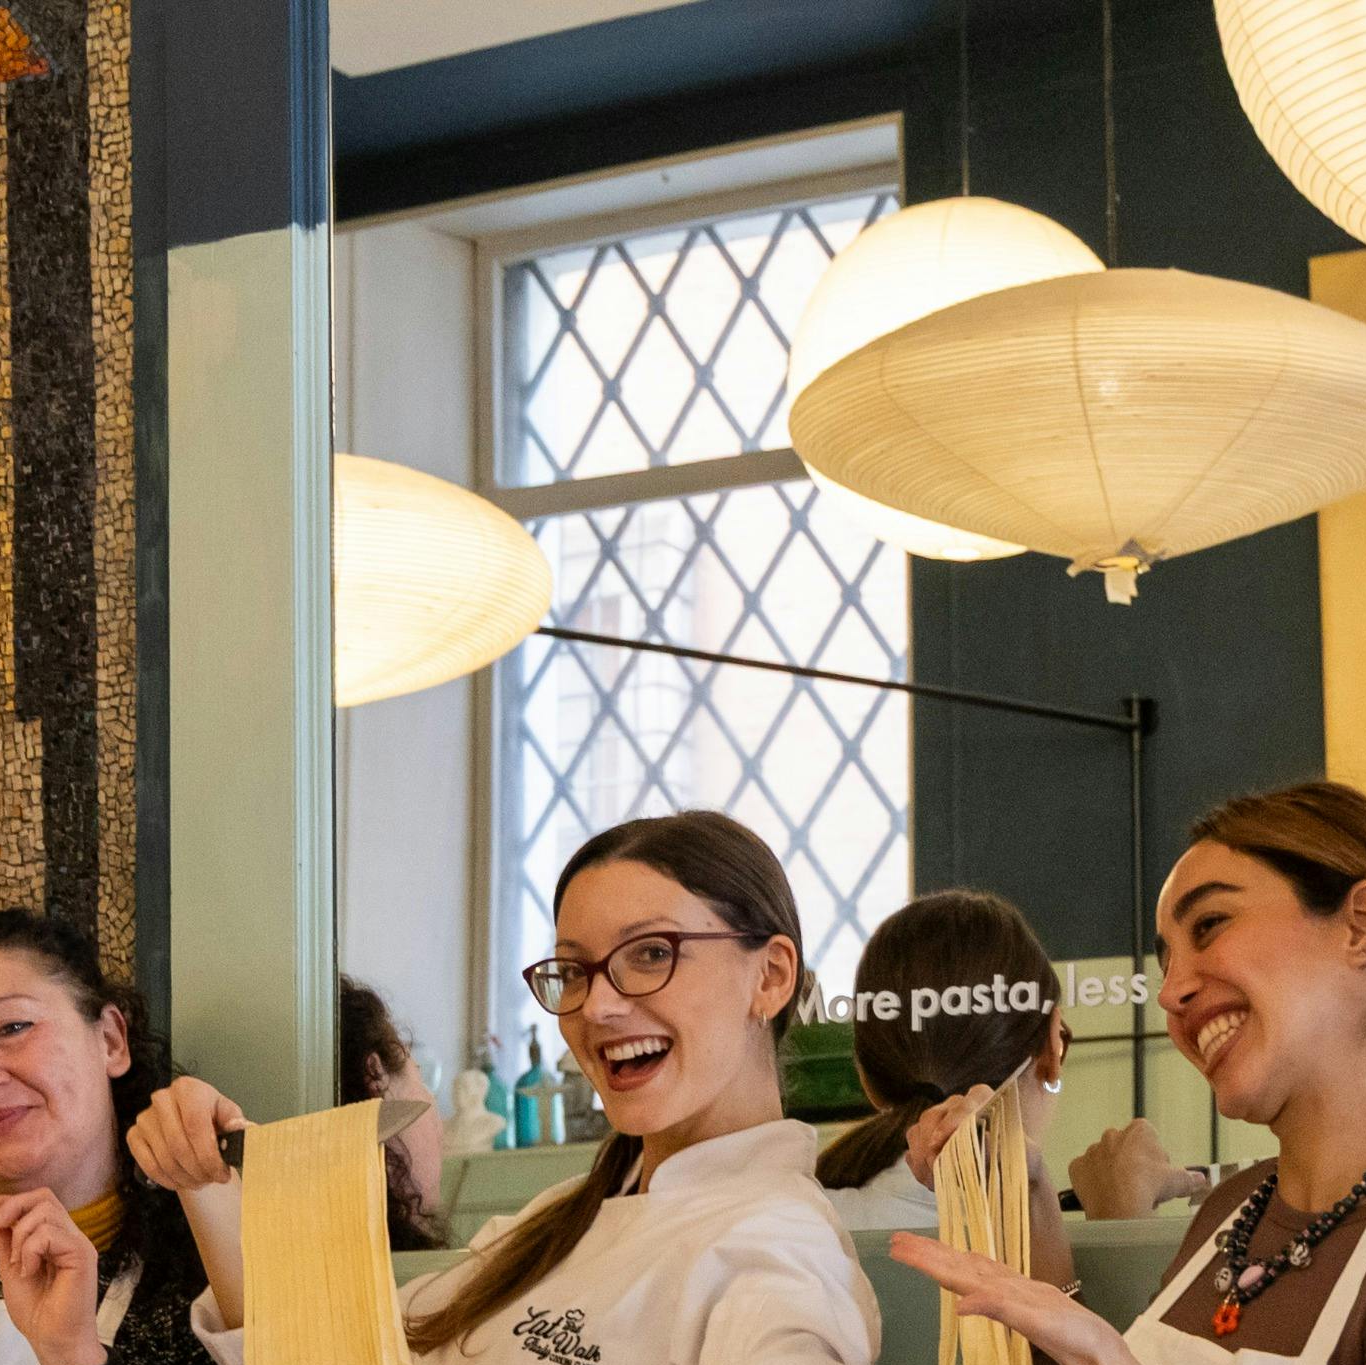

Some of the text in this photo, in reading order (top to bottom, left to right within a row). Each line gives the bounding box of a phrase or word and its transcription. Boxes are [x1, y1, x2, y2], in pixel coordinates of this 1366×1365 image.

[796, 963, 1148, 1032] More pasta, less
[552, 1332, 601, 1362] Walk
